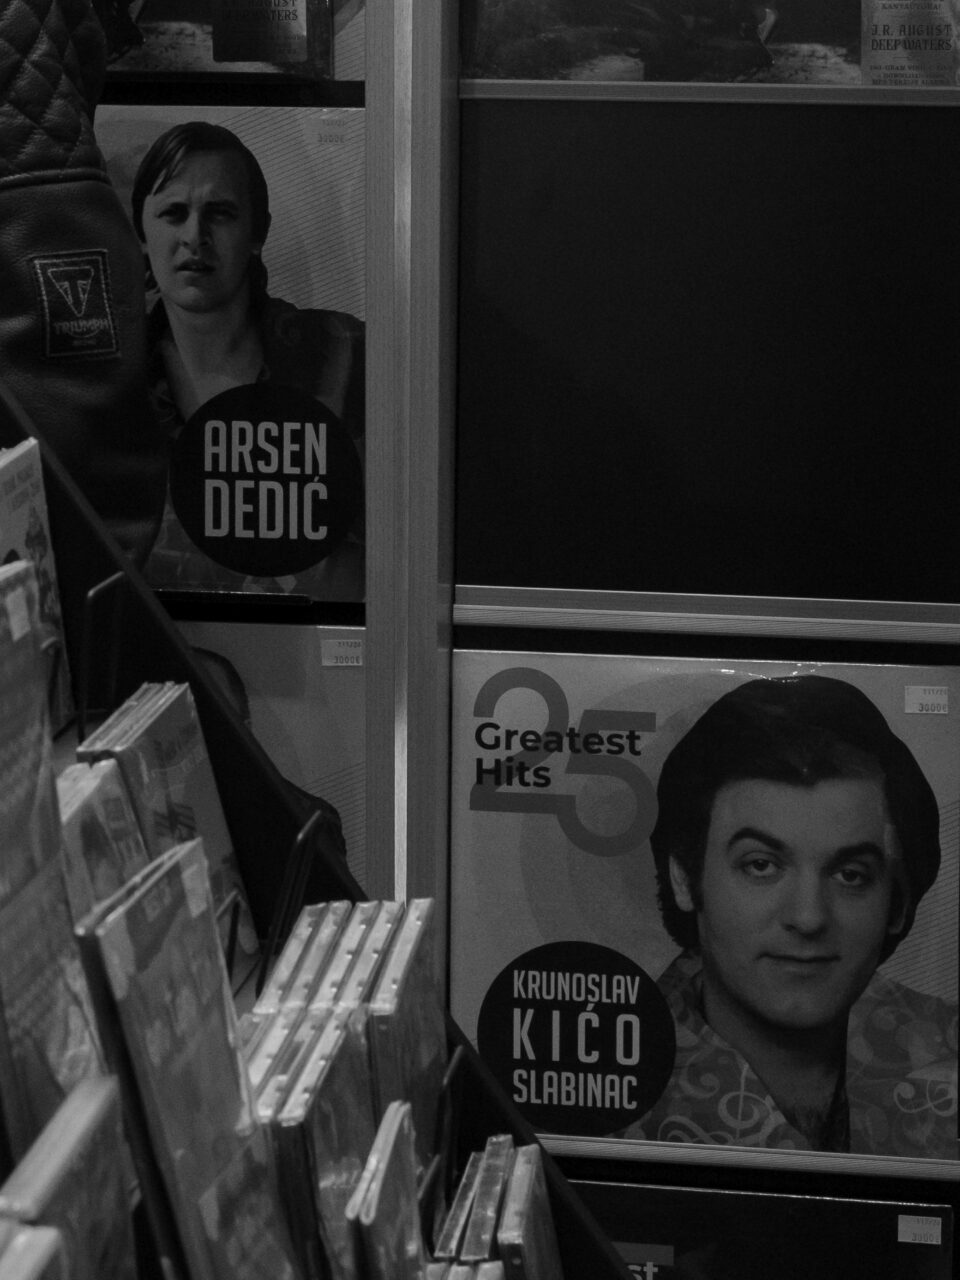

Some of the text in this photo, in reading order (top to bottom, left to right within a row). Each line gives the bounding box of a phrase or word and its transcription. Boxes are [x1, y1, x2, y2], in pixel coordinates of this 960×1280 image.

[871, 24, 952, 37] J.R. AUGUST
[871, 38, 953, 51] DEEP WATERS
[53, 318, 109, 335] TRIUMPH
[204, 420, 327, 475] ARSEN
[204, 476, 329, 540] DEDIĆ
[474, 722, 642, 757] Greatest
[474, 756, 552, 789] Hits
[512, 969, 641, 1006] KRUNOSLAV
[512, 1001, 641, 1067] KIĆO
[512, 1068, 638, 1110] SLABINAC
